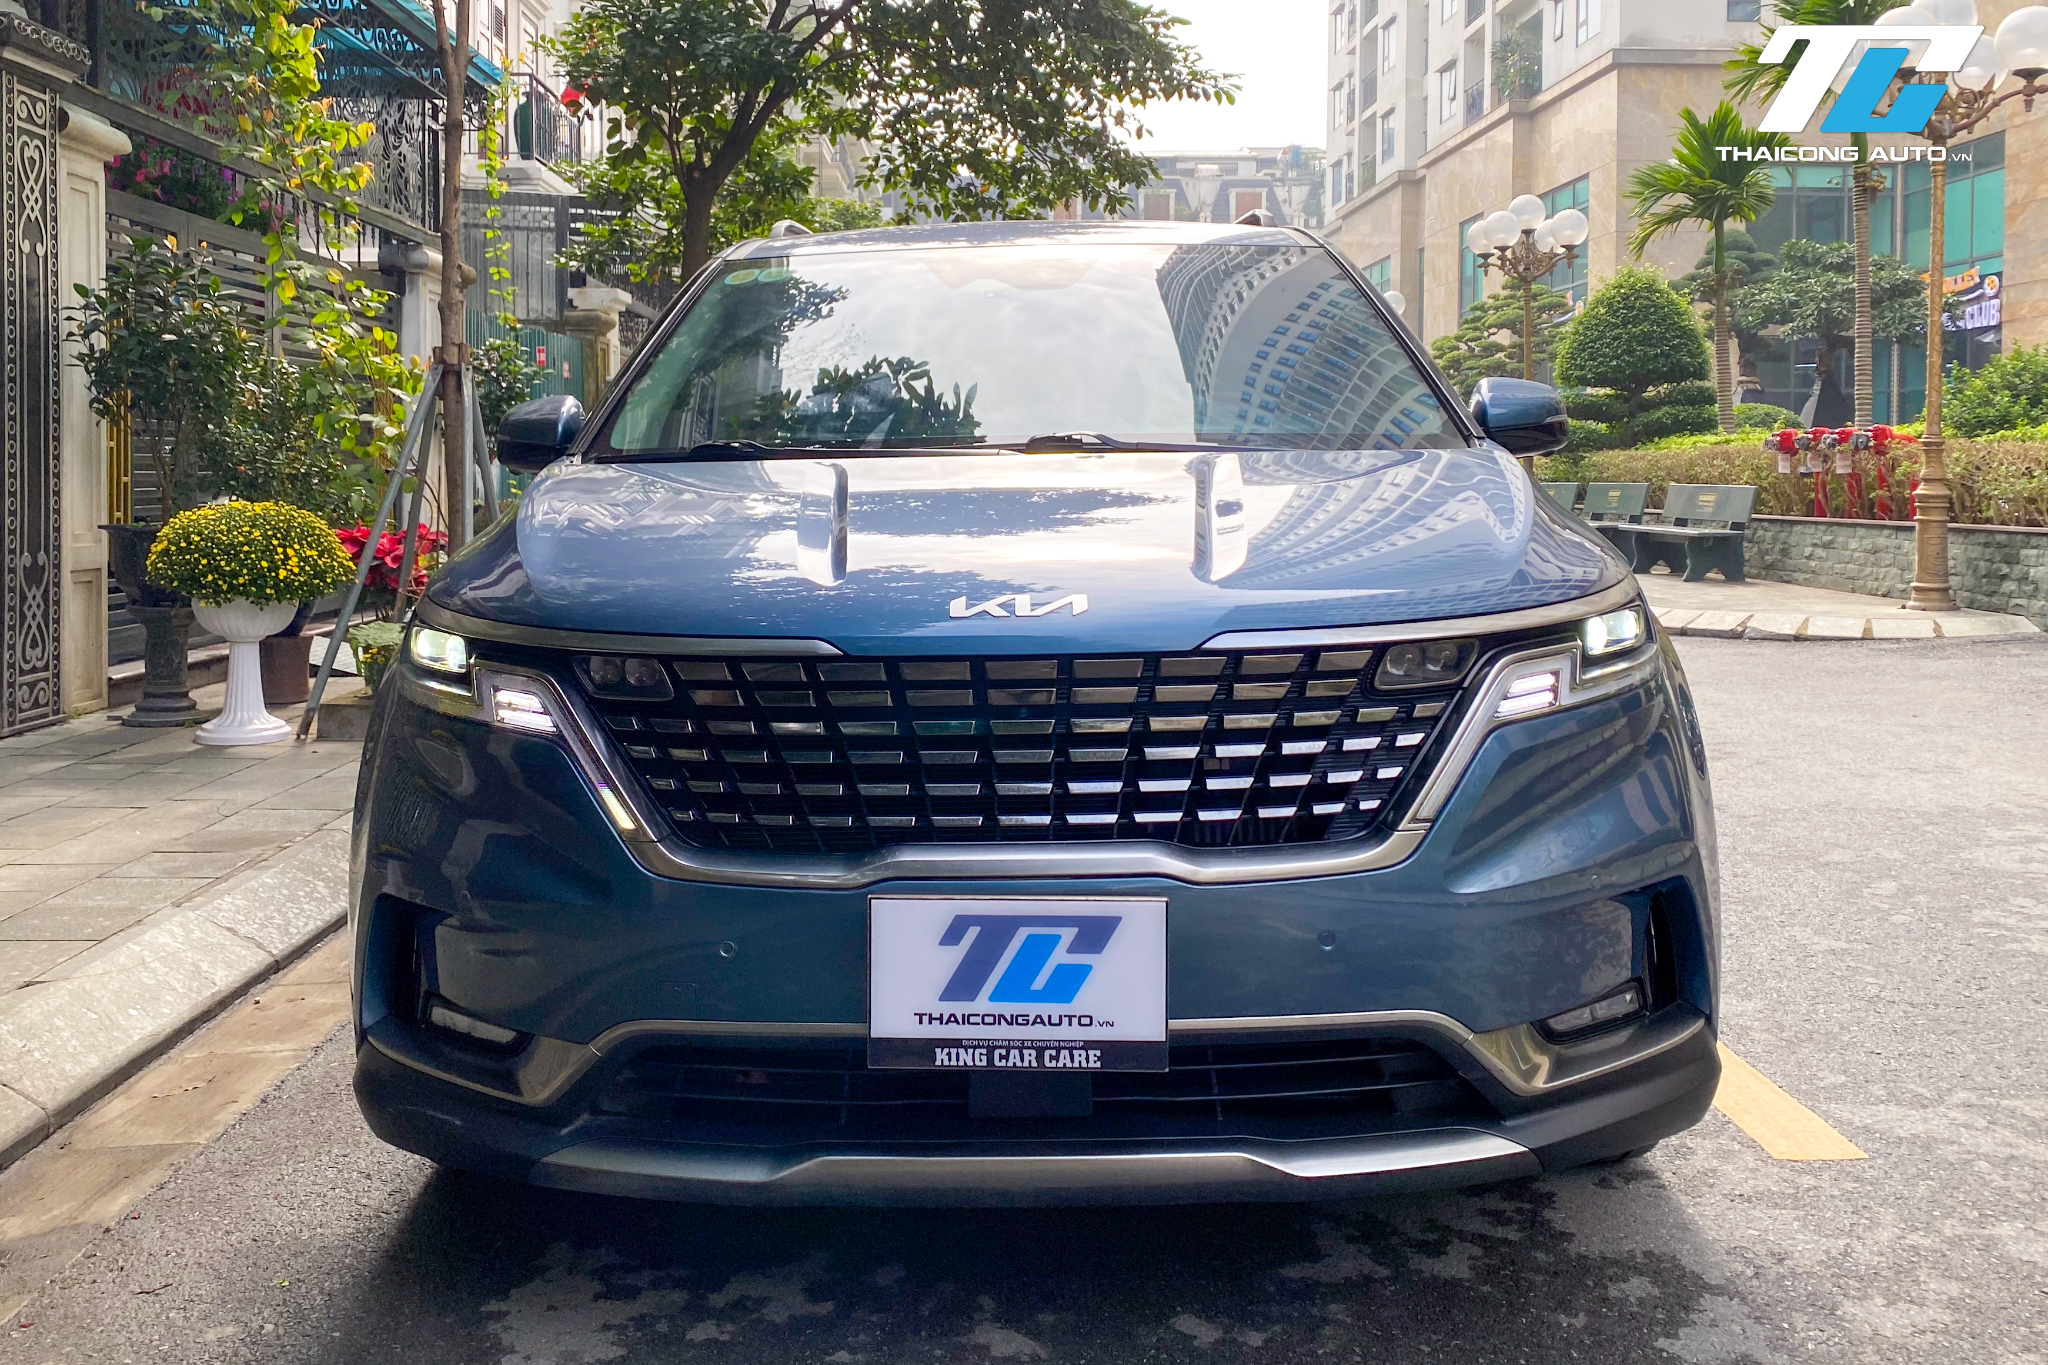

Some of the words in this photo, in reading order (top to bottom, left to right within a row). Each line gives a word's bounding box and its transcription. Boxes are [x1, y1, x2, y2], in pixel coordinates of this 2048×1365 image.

[1965, 298, 2000, 329] CLUB
[949, 593, 1089, 618] KIA
[934, 1047, 987, 1067] KING
[993, 1048, 1038, 1068] CAR
[1044, 1048, 1102, 1069] CARE
